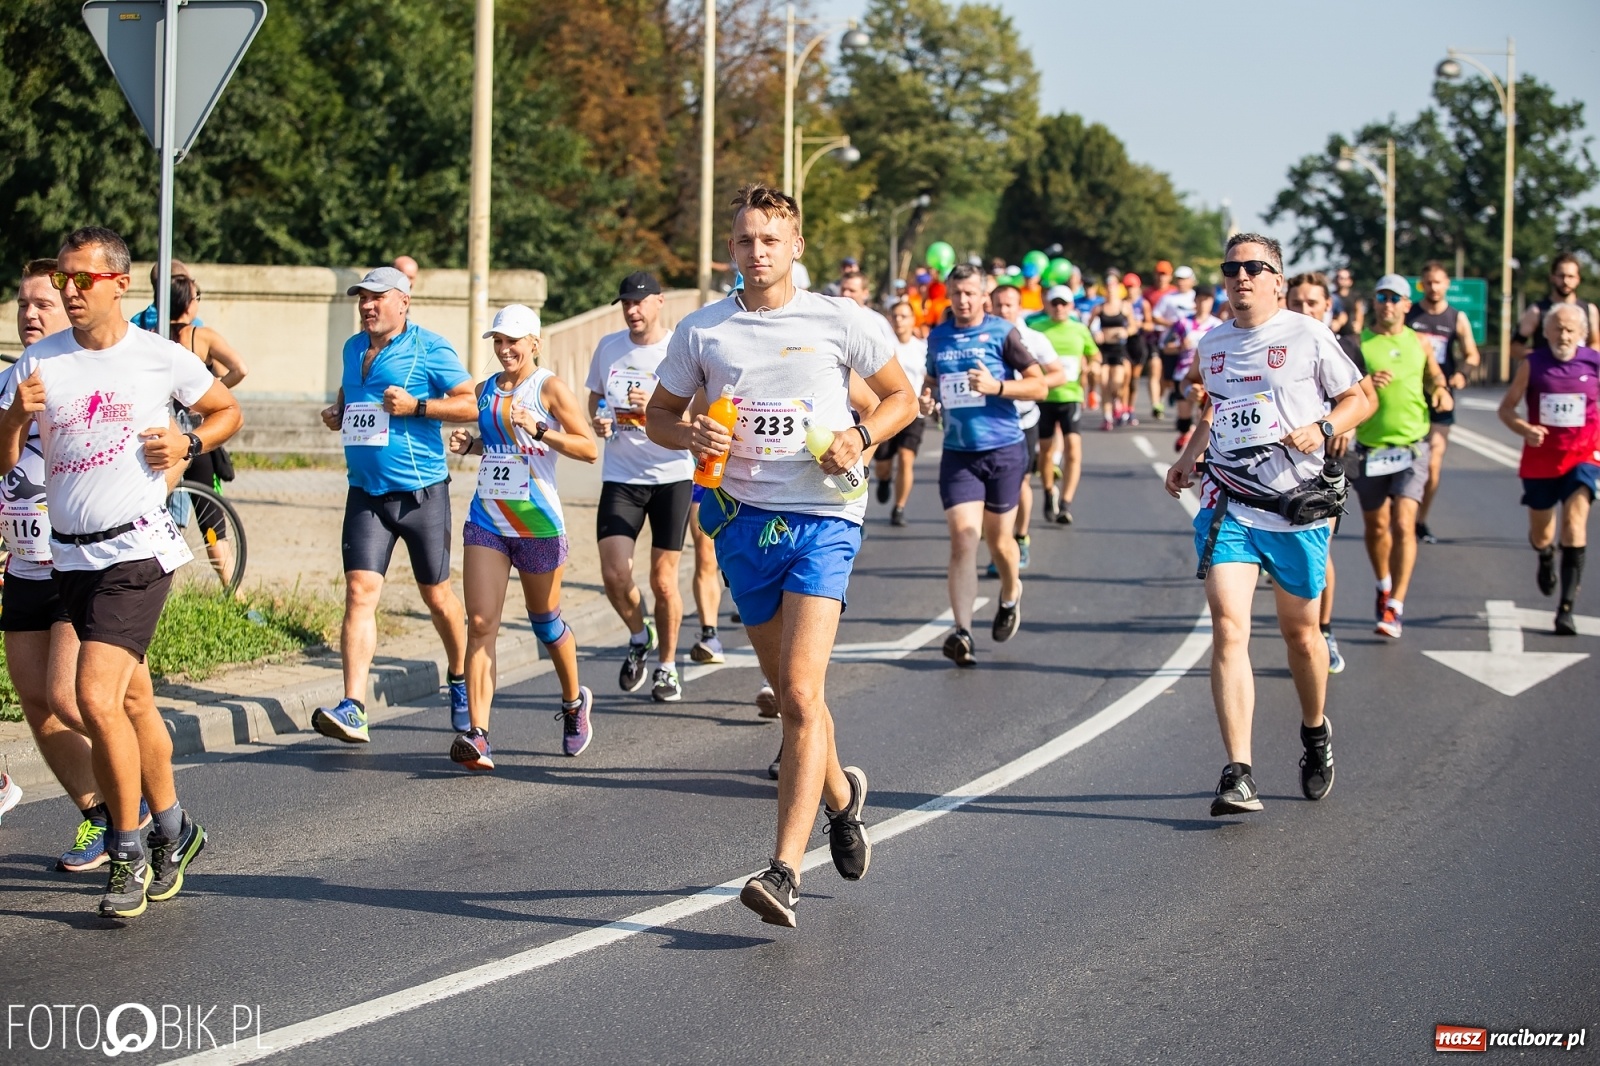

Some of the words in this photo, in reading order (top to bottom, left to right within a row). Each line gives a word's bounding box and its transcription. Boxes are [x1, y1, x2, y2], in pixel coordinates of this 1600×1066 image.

[104, 392, 115, 404] V
[98, 404, 134, 412] NOCNY
[102, 410, 127, 418] BIEG
[352, 414, 376, 428] 268
[1230, 408, 1260, 428] 366
[754, 416, 794, 436] 233
[493, 466, 510, 480] 22
[845, 471, 858, 488] OSH
[13, 520, 40, 538] 116
